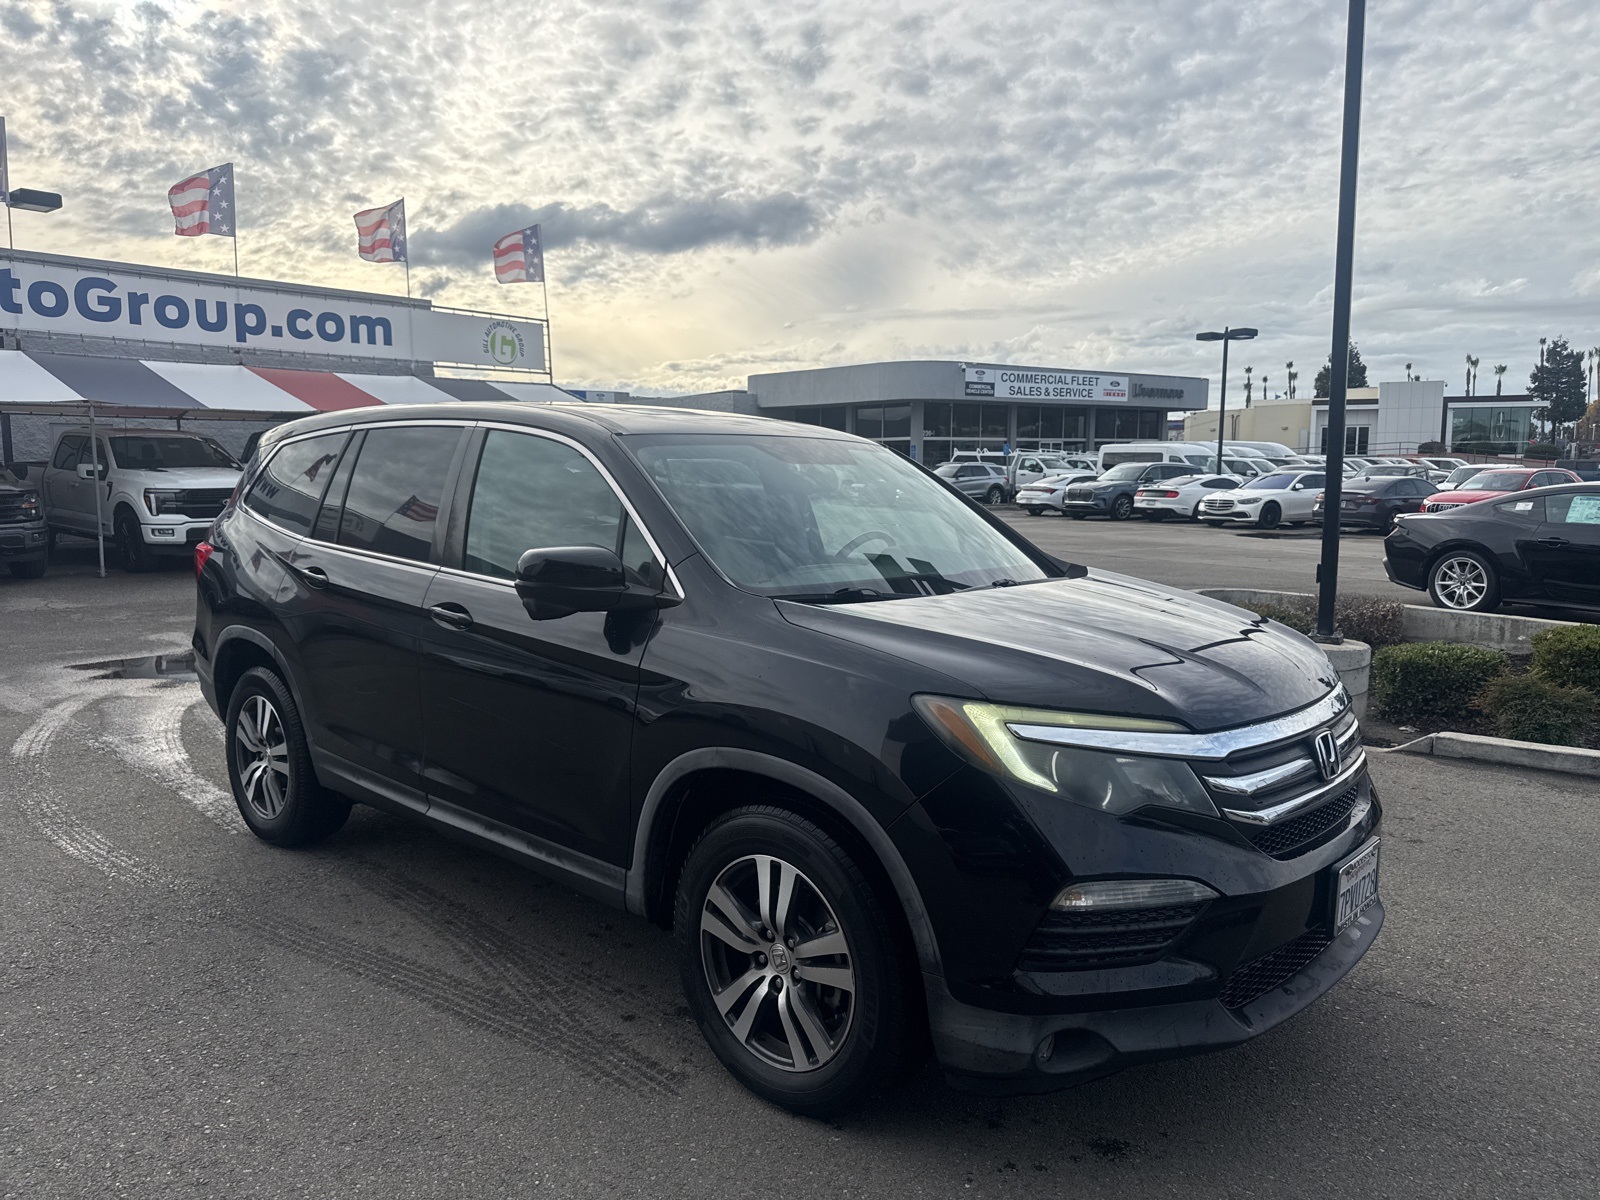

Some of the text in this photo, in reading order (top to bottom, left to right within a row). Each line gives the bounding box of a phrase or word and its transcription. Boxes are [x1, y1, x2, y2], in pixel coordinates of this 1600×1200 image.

[484, 320, 518, 339] AUTOMOTIVE
[515, 333, 525, 358] GROUP
[1000, 372, 1069, 385] COMMERCIAL
[1071, 375, 1100, 387] FLEET
[1008, 386, 1094, 398] SALES & SERVICE
